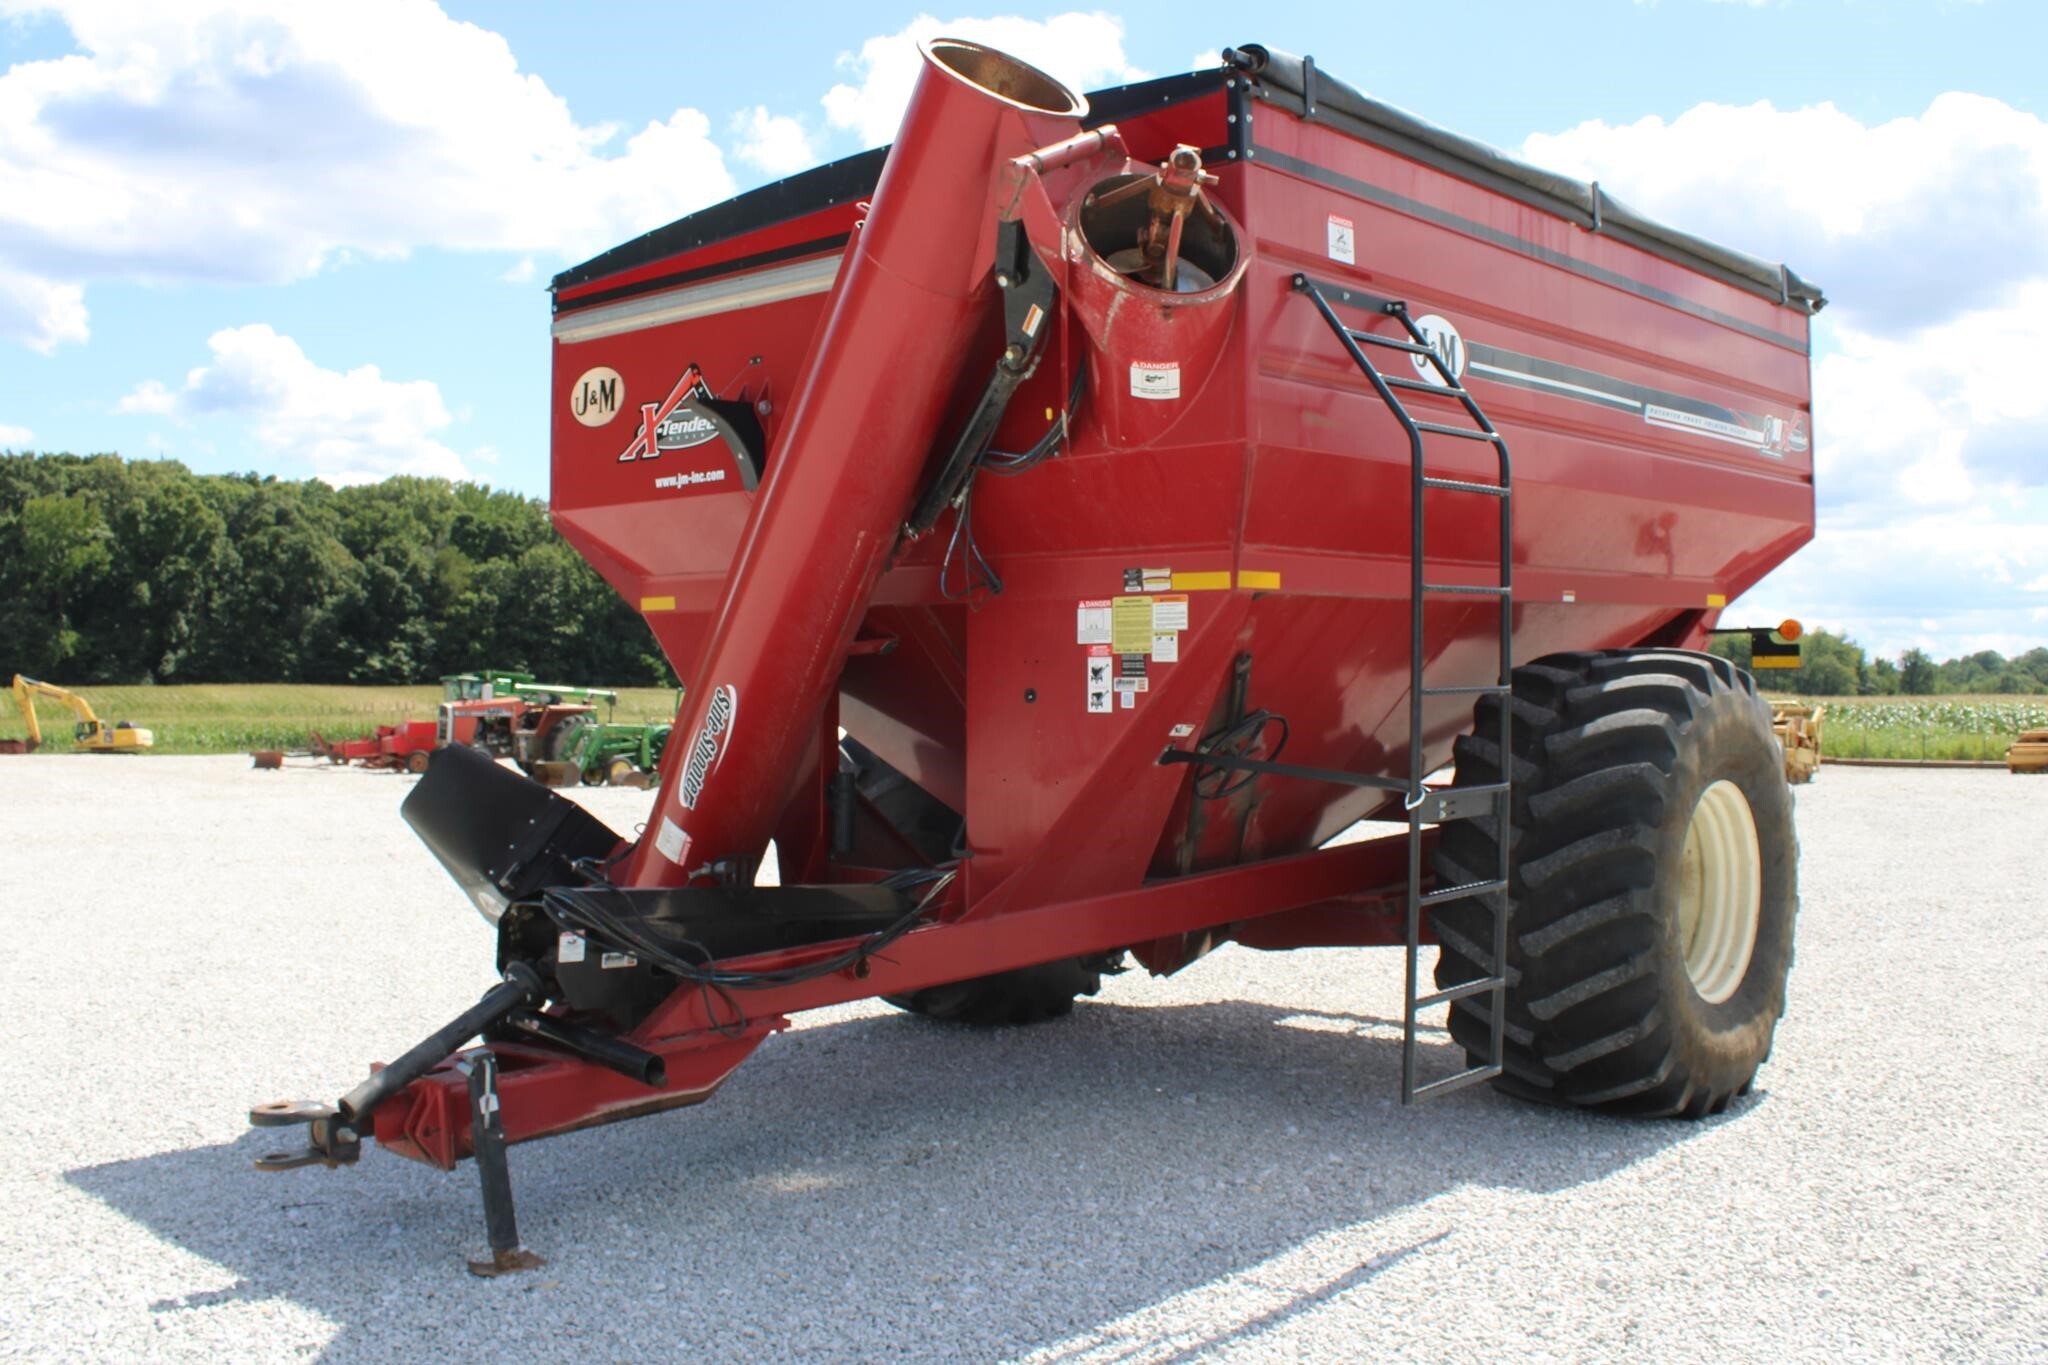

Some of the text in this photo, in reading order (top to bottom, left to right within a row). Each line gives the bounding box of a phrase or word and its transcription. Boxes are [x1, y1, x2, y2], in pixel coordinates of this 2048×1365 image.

[1140, 361, 1179, 370] DANGER
[575, 377, 616, 416] J&M
[655, 469, 725, 489] www.jm-inc.com
[1085, 599, 1111, 608] DANGER
[681, 687, 731, 811] Side-Shooter
